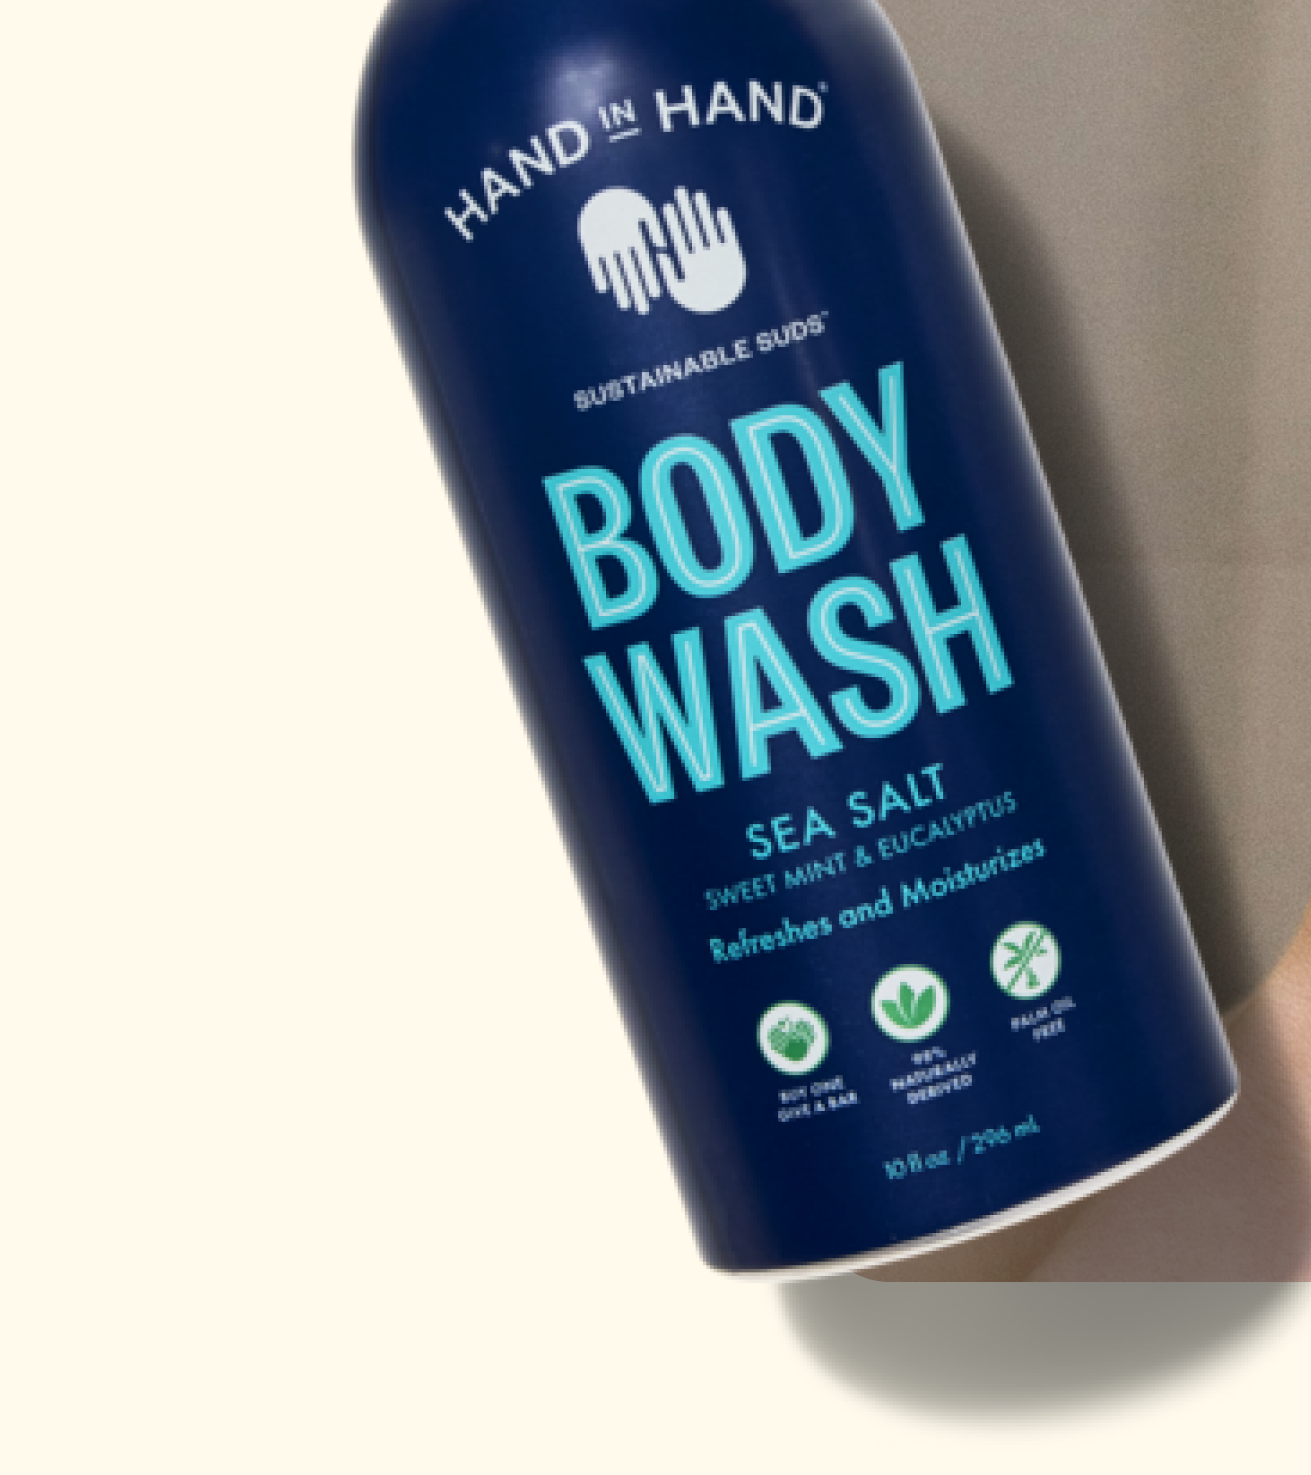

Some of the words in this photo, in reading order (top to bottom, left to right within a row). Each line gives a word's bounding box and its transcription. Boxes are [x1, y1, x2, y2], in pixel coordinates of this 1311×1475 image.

[444, 119, 590, 241] HAND
[598, 99, 638, 131] IN
[573, 338, 753, 411] SUSTAINABLE
[542, 361, 925, 631] BODY
[583, 533, 1015, 806] WASH
[704, 873, 777, 911] SWEET
[784, 851, 847, 890] MINT
[853, 845, 874, 868] &
[876, 790, 1018, 861] EUCALYPTUS
[746, 806, 836, 860] SEA
[846, 762, 945, 828] SALT
[709, 916, 833, 964] Refreshes
[838, 885, 894, 929] and
[902, 837, 1047, 909] Moisturizes
[889, 1050, 978, 1093] NATURALLY
[907, 1074, 973, 1105] DERIVED
